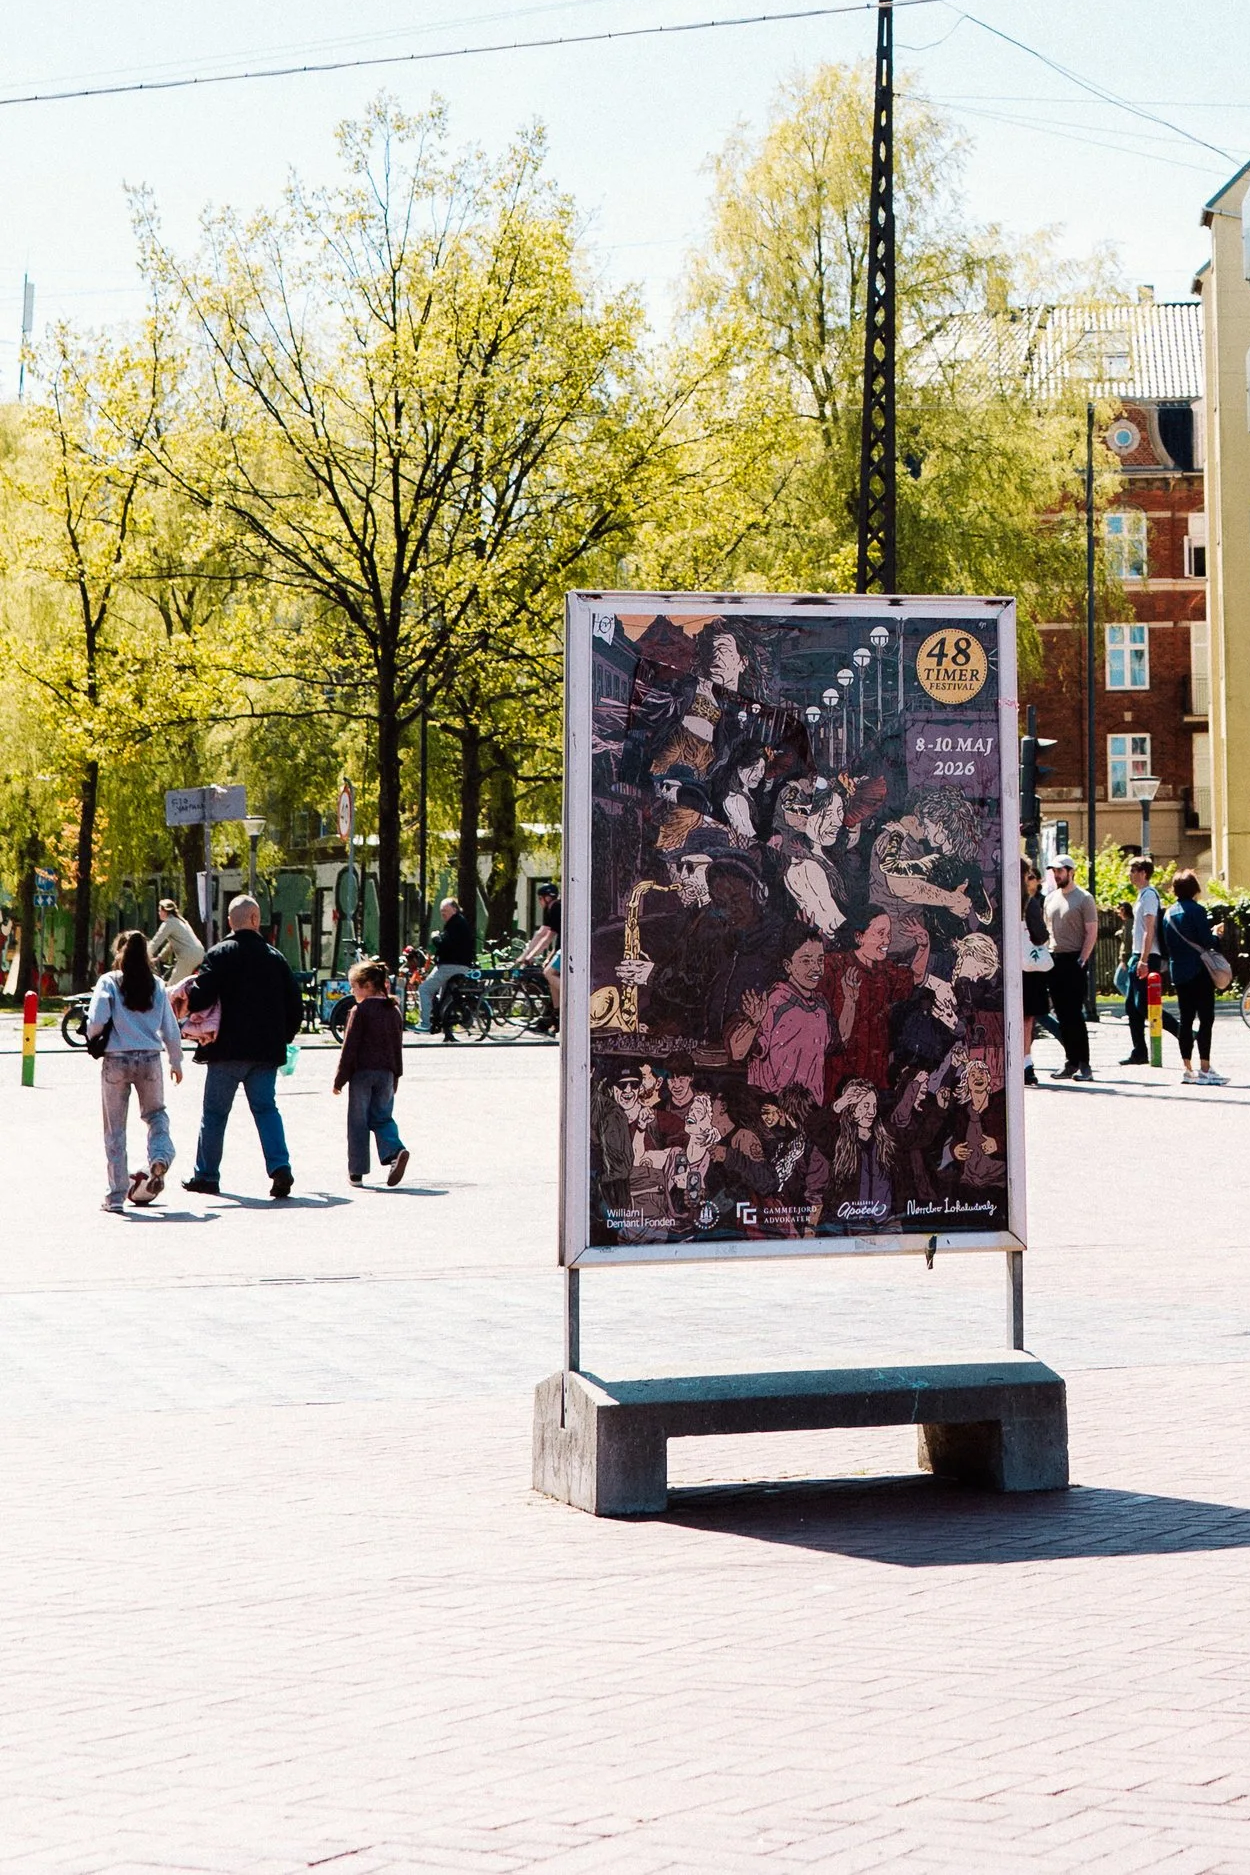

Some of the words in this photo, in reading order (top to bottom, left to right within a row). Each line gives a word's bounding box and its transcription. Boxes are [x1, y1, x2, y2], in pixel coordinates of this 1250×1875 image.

[926, 637, 971, 667] 48
[924, 668, 980, 682] TIMER
[929, 682, 975, 691] FESTIVAL
[955, 737, 994, 756] MAJ
[933, 761, 975, 775] 2026
[763, 1206, 817, 1214] GAMMELJORD
[907, 1199, 942, 1215] Nørrebro
[944, 1197, 997, 1216] Lokaludvalg
[606, 1208, 640, 1218] William
[606, 1219, 640, 1228] Demant
[644, 1217, 676, 1227] Fonden
[764, 1216, 811, 1224] ADVOKATER
